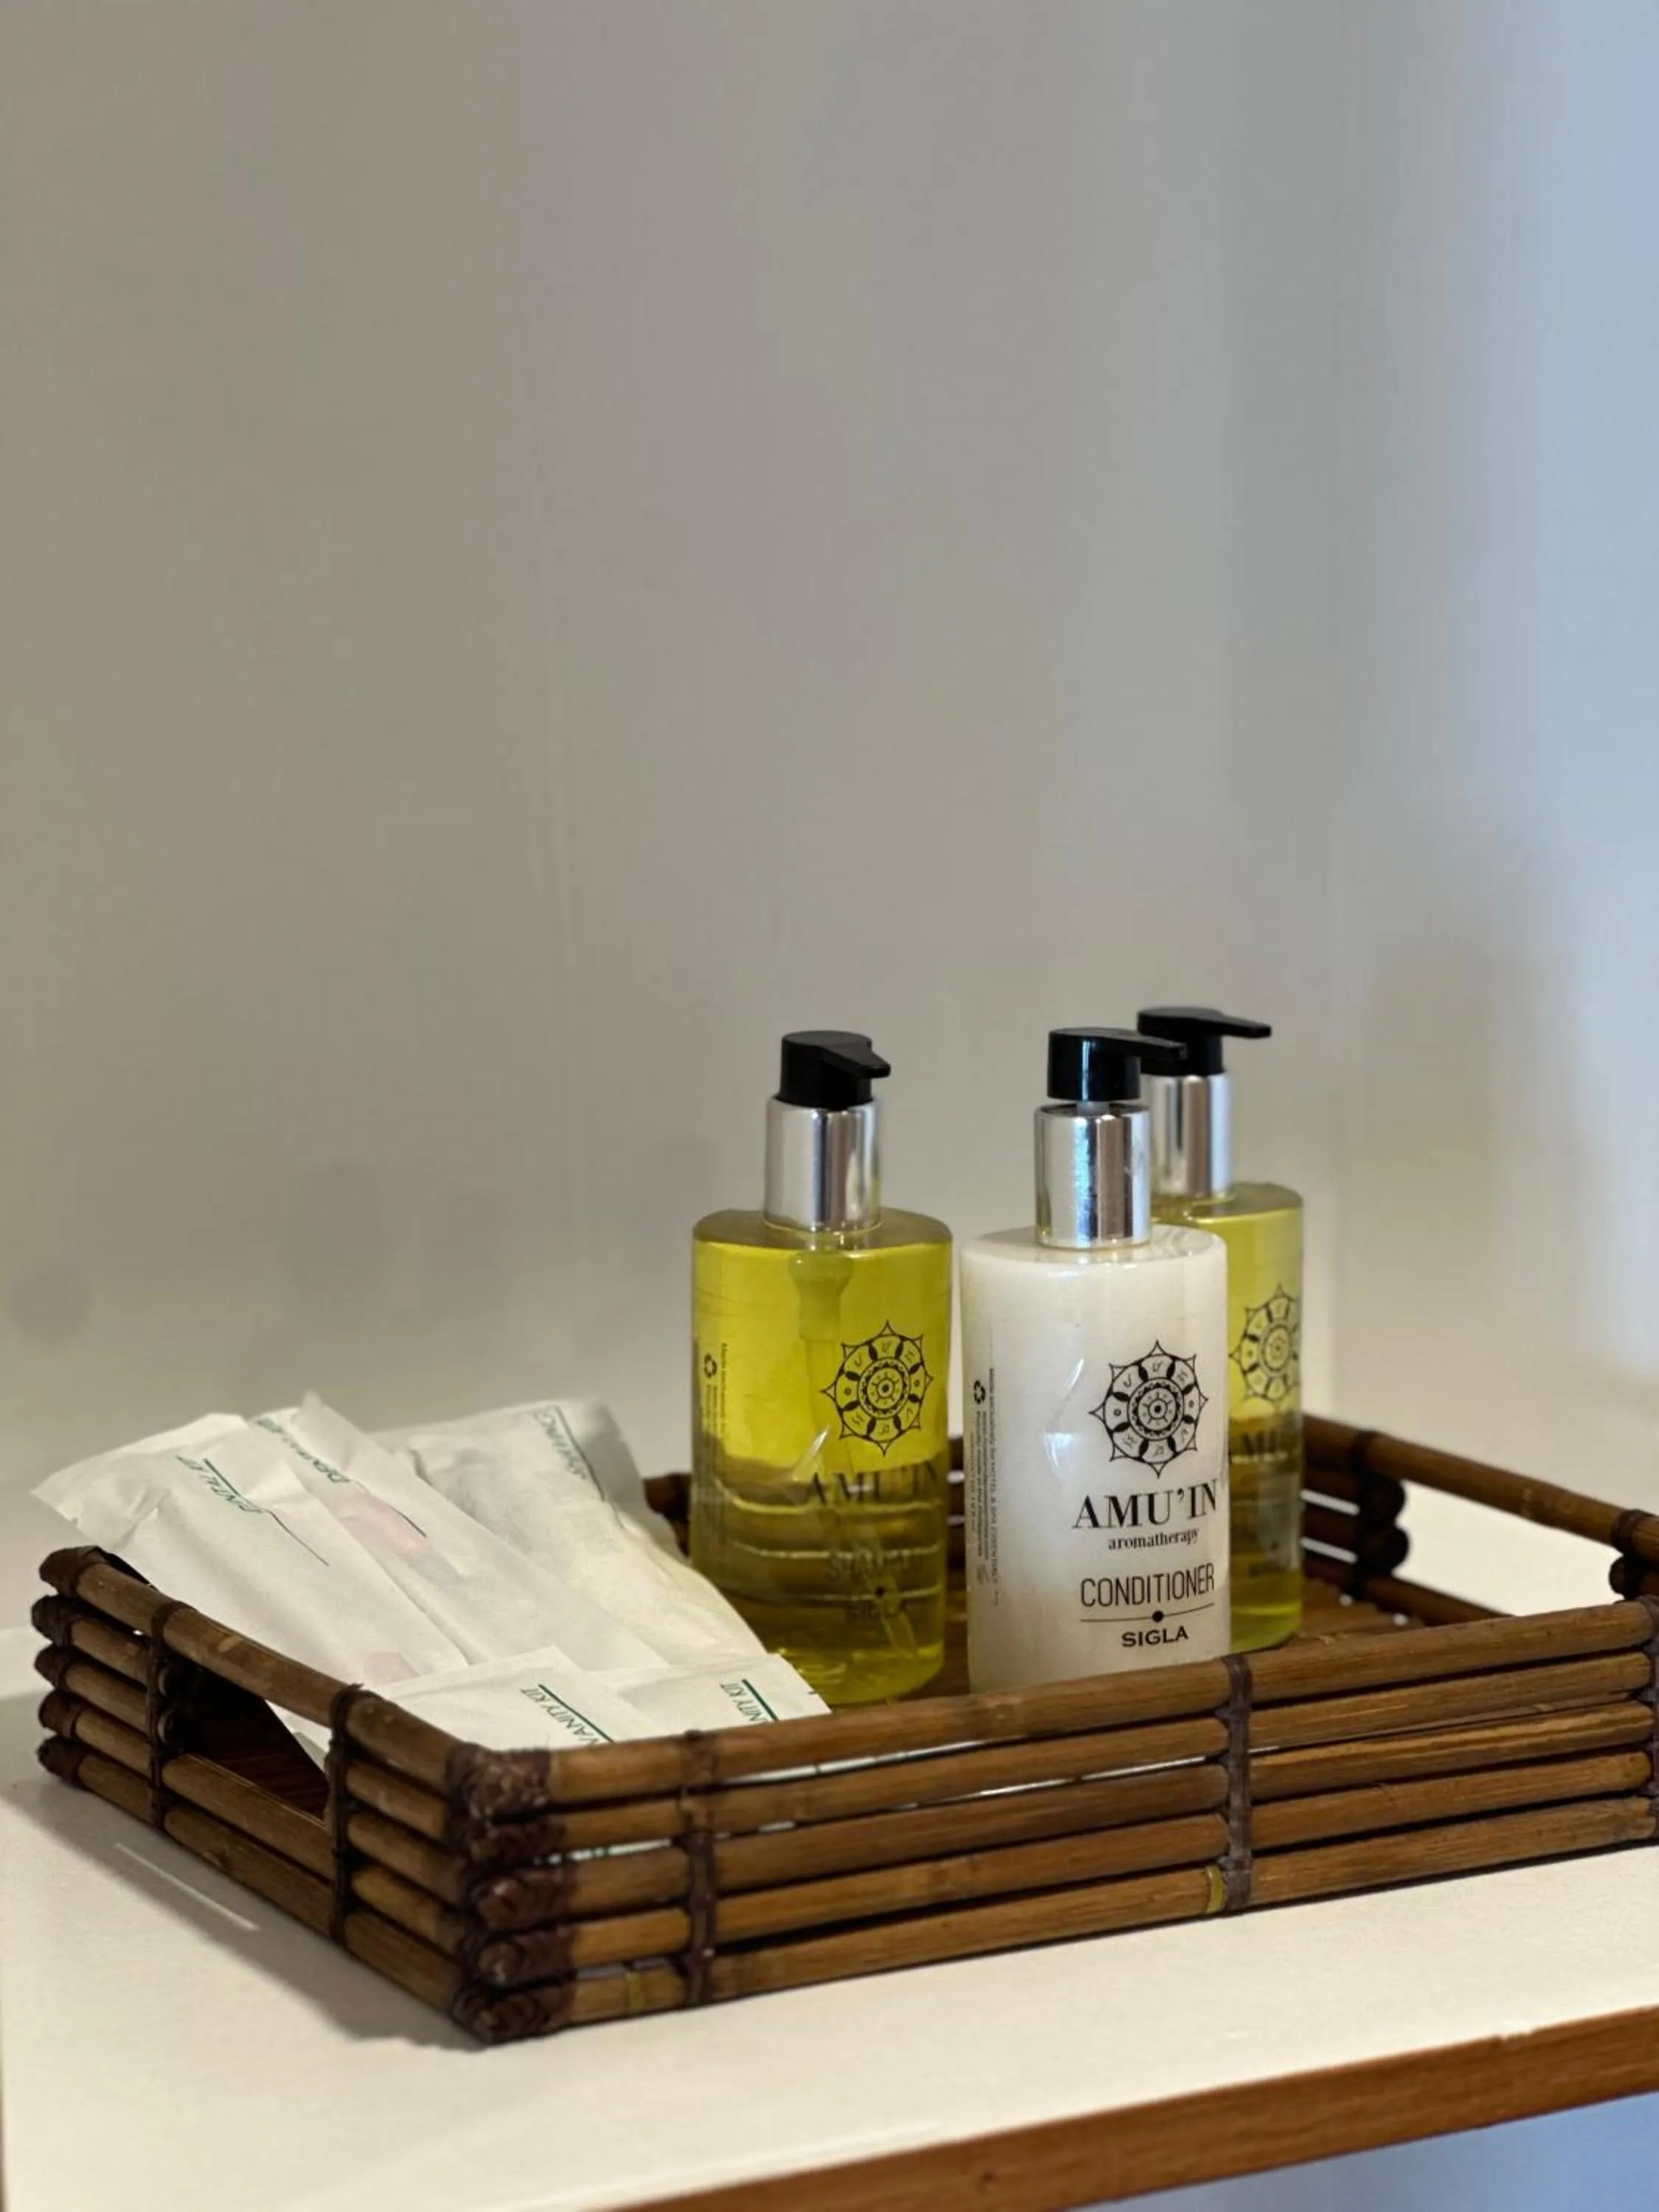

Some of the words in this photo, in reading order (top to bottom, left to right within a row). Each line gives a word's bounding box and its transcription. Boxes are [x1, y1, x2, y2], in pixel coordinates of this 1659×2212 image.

[1071, 1478, 1218, 1529] AMU'IN
[1108, 1528, 1200, 1550] aromatherapy
[1080, 1562, 1215, 1607] CONDITIONER
[1121, 1626, 1189, 1647] SIGLA
[540, 1705, 599, 1745] VANITY
[733, 1700, 768, 1722] NITY
